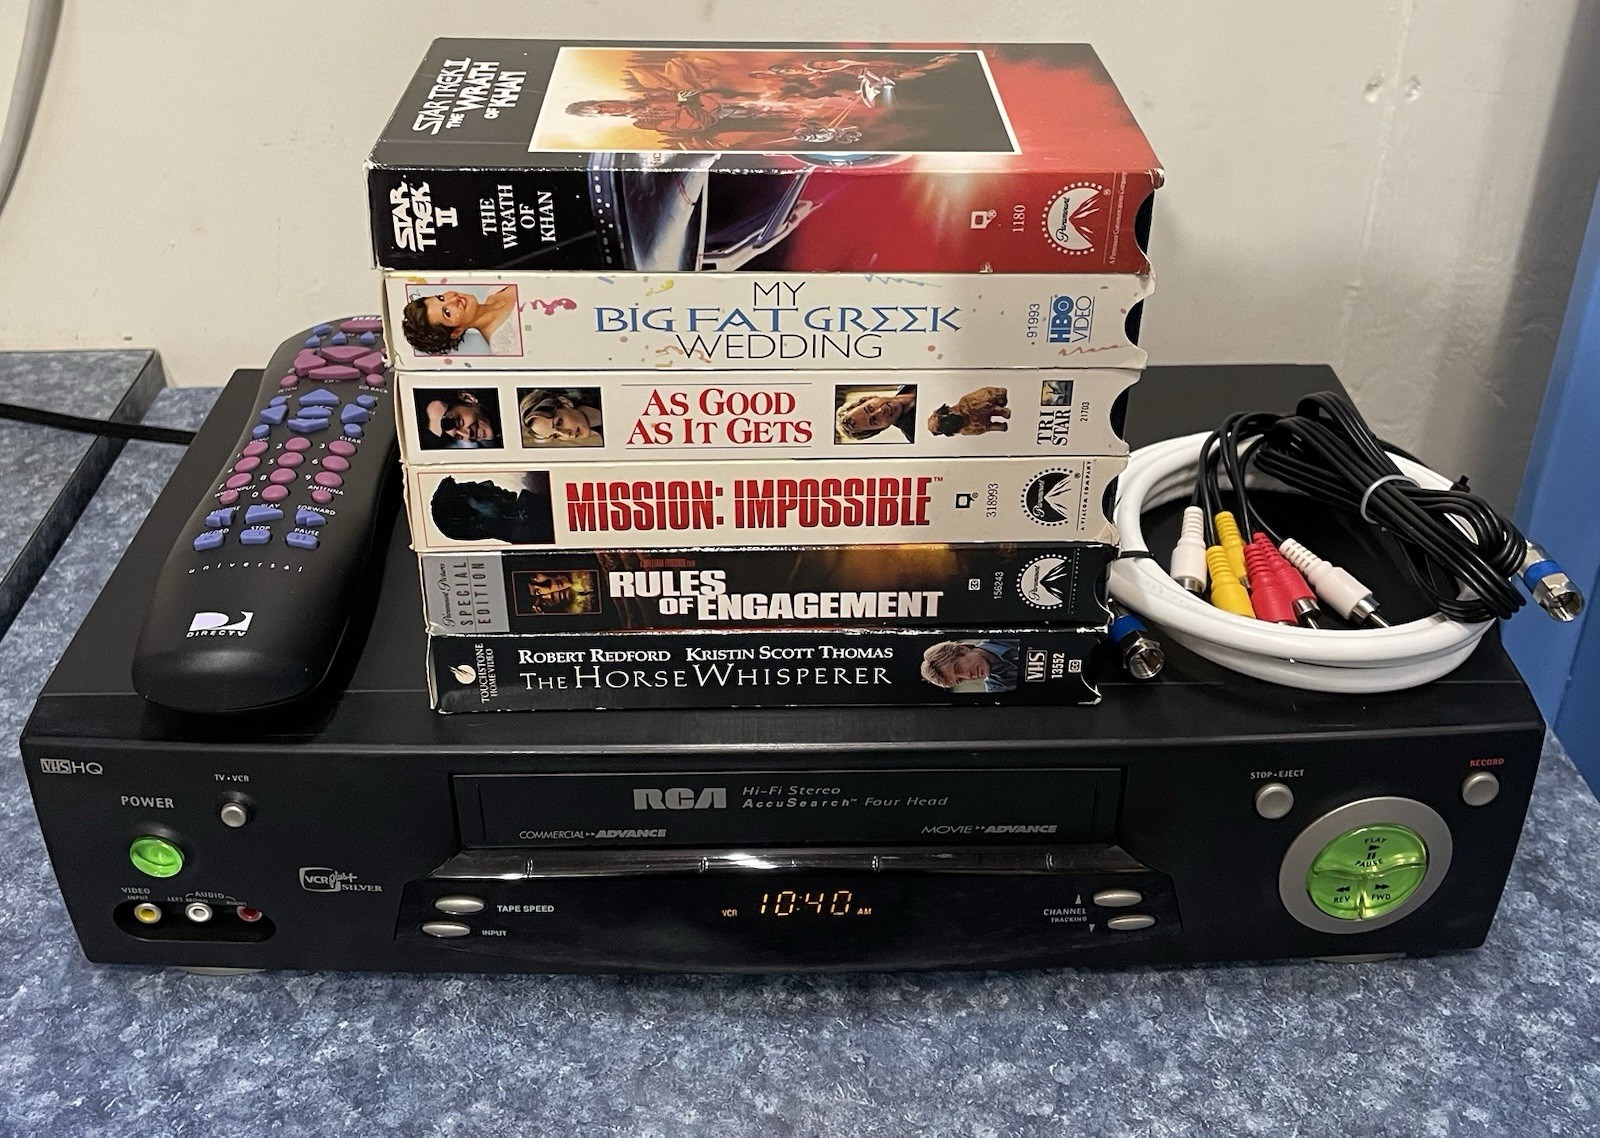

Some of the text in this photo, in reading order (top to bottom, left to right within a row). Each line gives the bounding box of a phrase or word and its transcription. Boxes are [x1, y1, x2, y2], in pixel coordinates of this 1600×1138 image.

[412, 57, 471, 135] STAR TREK II
[445, 62, 500, 129] THE WRATH
[484, 71, 527, 119] OF KHAN
[389, 181, 417, 252] STAR
[409, 181, 438, 251] TREK
[435, 206, 459, 229] II
[479, 198, 498, 236] THE
[498, 184, 518, 249] WRATH
[519, 203, 536, 229] OF
[537, 190, 557, 243] KHAN
[1012, 203, 1026, 234] 1180
[754, 281, 806, 307] MY
[594, 303, 673, 333] BIG
[686, 307, 799, 333] FAT
[1026, 303, 1041, 338] 91993
[1050, 295, 1075, 343] HBO
[1072, 295, 1092, 343] VIDEO
[675, 333, 883, 359] WEDDING
[642, 388, 796, 416] AS GOOD
[1080, 401, 1090, 422] 21703
[339, 435, 362, 444] CLEAR
[626, 417, 813, 445] AS IT GETS
[1036, 410, 1055, 446] TRI
[1052, 409, 1072, 446] STAR
[307, 485, 344, 496] ANTENNA
[986, 482, 999, 518] 318993
[297, 504, 337, 516] FORWARD
[565, 480, 725, 531] MISSION:
[294, 527, 320, 536] PAUSE
[188, 562, 304, 574] universal
[453, 561, 474, 626] SPECIAL
[471, 562, 492, 624] EDITION
[608, 570, 726, 597] RULES
[993, 571, 1005, 600] 156243
[659, 591, 944, 621] OF ENGAGEMENT
[186, 630, 247, 638] DIRECTV
[518, 645, 894, 664] ROBERT REDFORD KRISTIN SCOTT THOMAS
[1026, 651, 1046, 681] VHS
[1051, 652, 1065, 680] 13552
[475, 643, 491, 703] TOUCHSTONE
[485, 648, 498, 697] HOME VIDEO
[519, 663, 893, 690] THE HORSE WHISPERER
[40, 758, 104, 775] VHS HQ
[1469, 758, 1505, 767] RECORD
[231, 774, 250, 782] VCR
[743, 784, 841, 796] Hi-Fi Stereo
[120, 795, 174, 809] POWER
[633, 787, 727, 810] RCA
[865, 797, 901, 808] Four
[907, 796, 949, 807] Head
[519, 828, 667, 839] COMMERCIAL ADVANCE
[921, 824, 1058, 834] MOVIE ADVANCE
[1355, 858, 1384, 868] PAUSE
[121, 886, 151, 895] VIDEO
[304, 875, 329, 884] VCR
[341, 883, 383, 892] SILVER
[194, 891, 225, 899] AUDIO
[722, 909, 738, 918] VCR
[761, 890, 852, 917] 10:40
[1333, 895, 1350, 904] REV
[1371, 893, 1391, 901] FWD
[497, 904, 555, 913] TAPE SPEED
[1043, 907, 1087, 917] CHANNEL
[1050, 916, 1088, 924] TRACKING
[482, 929, 507, 937] INPUT
